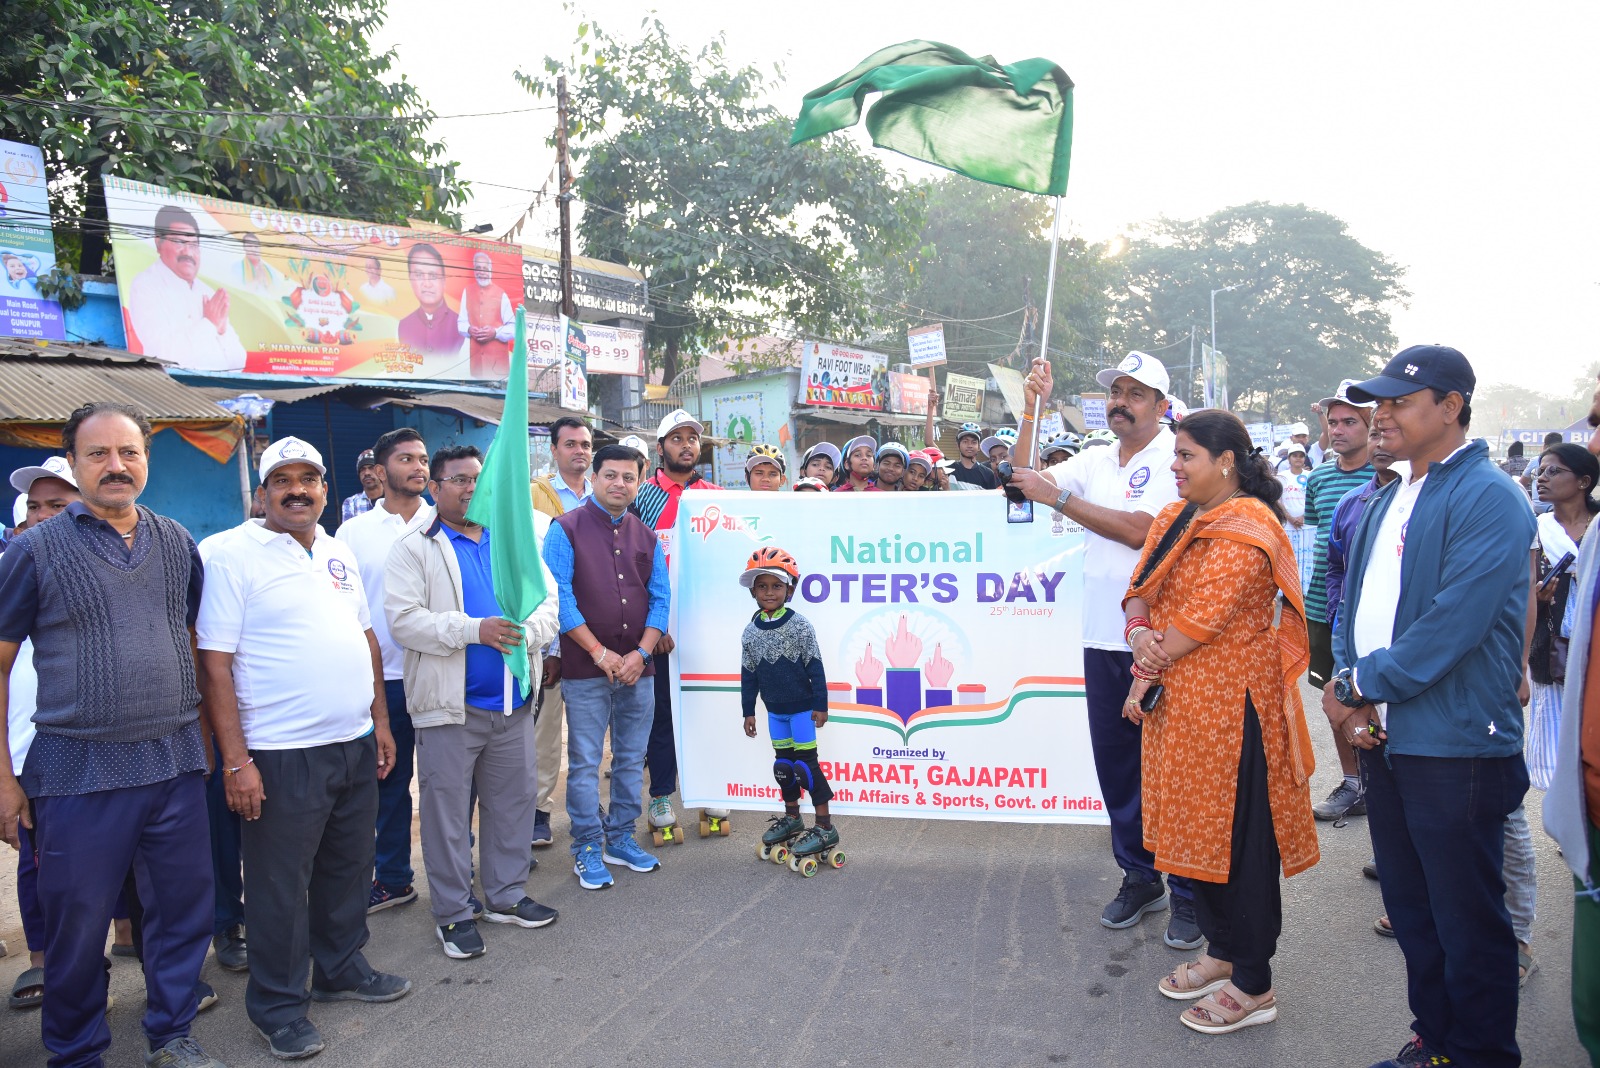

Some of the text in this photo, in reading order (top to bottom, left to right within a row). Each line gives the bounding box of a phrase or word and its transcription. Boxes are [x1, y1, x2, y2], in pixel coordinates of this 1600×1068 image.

[6, 299, 39, 311] Main Road,
[10, 309, 20, 317] Ice
[21, 311, 40, 319] cream
[40, 312, 58, 320] Parlor
[10, 319, 41, 328] GUNUPUR
[271, 344, 319, 354] NARAYANA
[321, 346, 340, 355] RAO
[374, 351, 423, 365] NEW YEAR
[817, 357, 871, 376] RAVI FOOT WEAR
[946, 383, 977, 404] Mamata
[1519, 431, 1564, 443] CIT
[831, 532, 983, 564] National
[976, 572, 1066, 604] DAY
[989, 605, 1054, 618] 25th January
[872, 746, 946, 761] Organized by
[819, 761, 919, 790] BHARAT,
[926, 765, 1048, 789] GAJAPATI
[831, 788, 853, 802] uth
[858, 788, 910, 805] Affairs
[915, 791, 927, 806] &
[932, 792, 989, 811] Sports,
[994, 794, 1037, 809] Govt.
[1041, 796, 1058, 810] of
[1062, 796, 1103, 811] india
